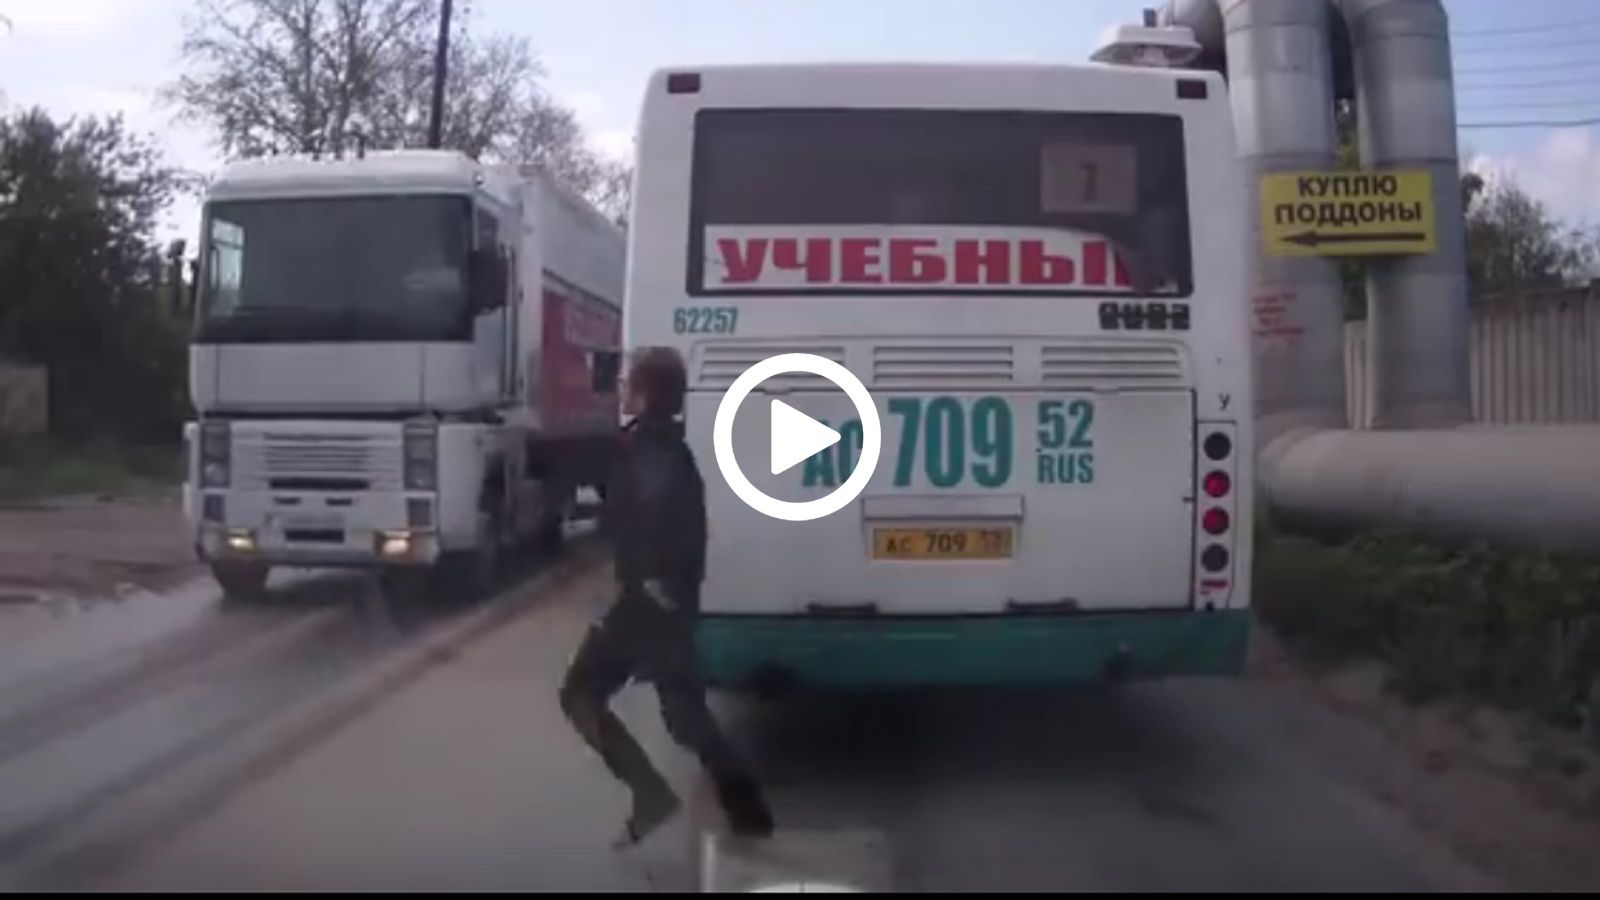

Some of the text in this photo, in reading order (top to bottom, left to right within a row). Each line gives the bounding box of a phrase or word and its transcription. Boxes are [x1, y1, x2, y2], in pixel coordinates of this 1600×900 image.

[1297, 175, 1398, 197] КУПЛЮ
[1275, 201, 1422, 227] ПОДДОНЫ
[673, 306, 738, 335] 62257
[1037, 400, 1095, 449] 52
[887, 395, 1013, 489] 709
[1037, 453, 1093, 484] RUS
[925, 531, 966, 553] 709
